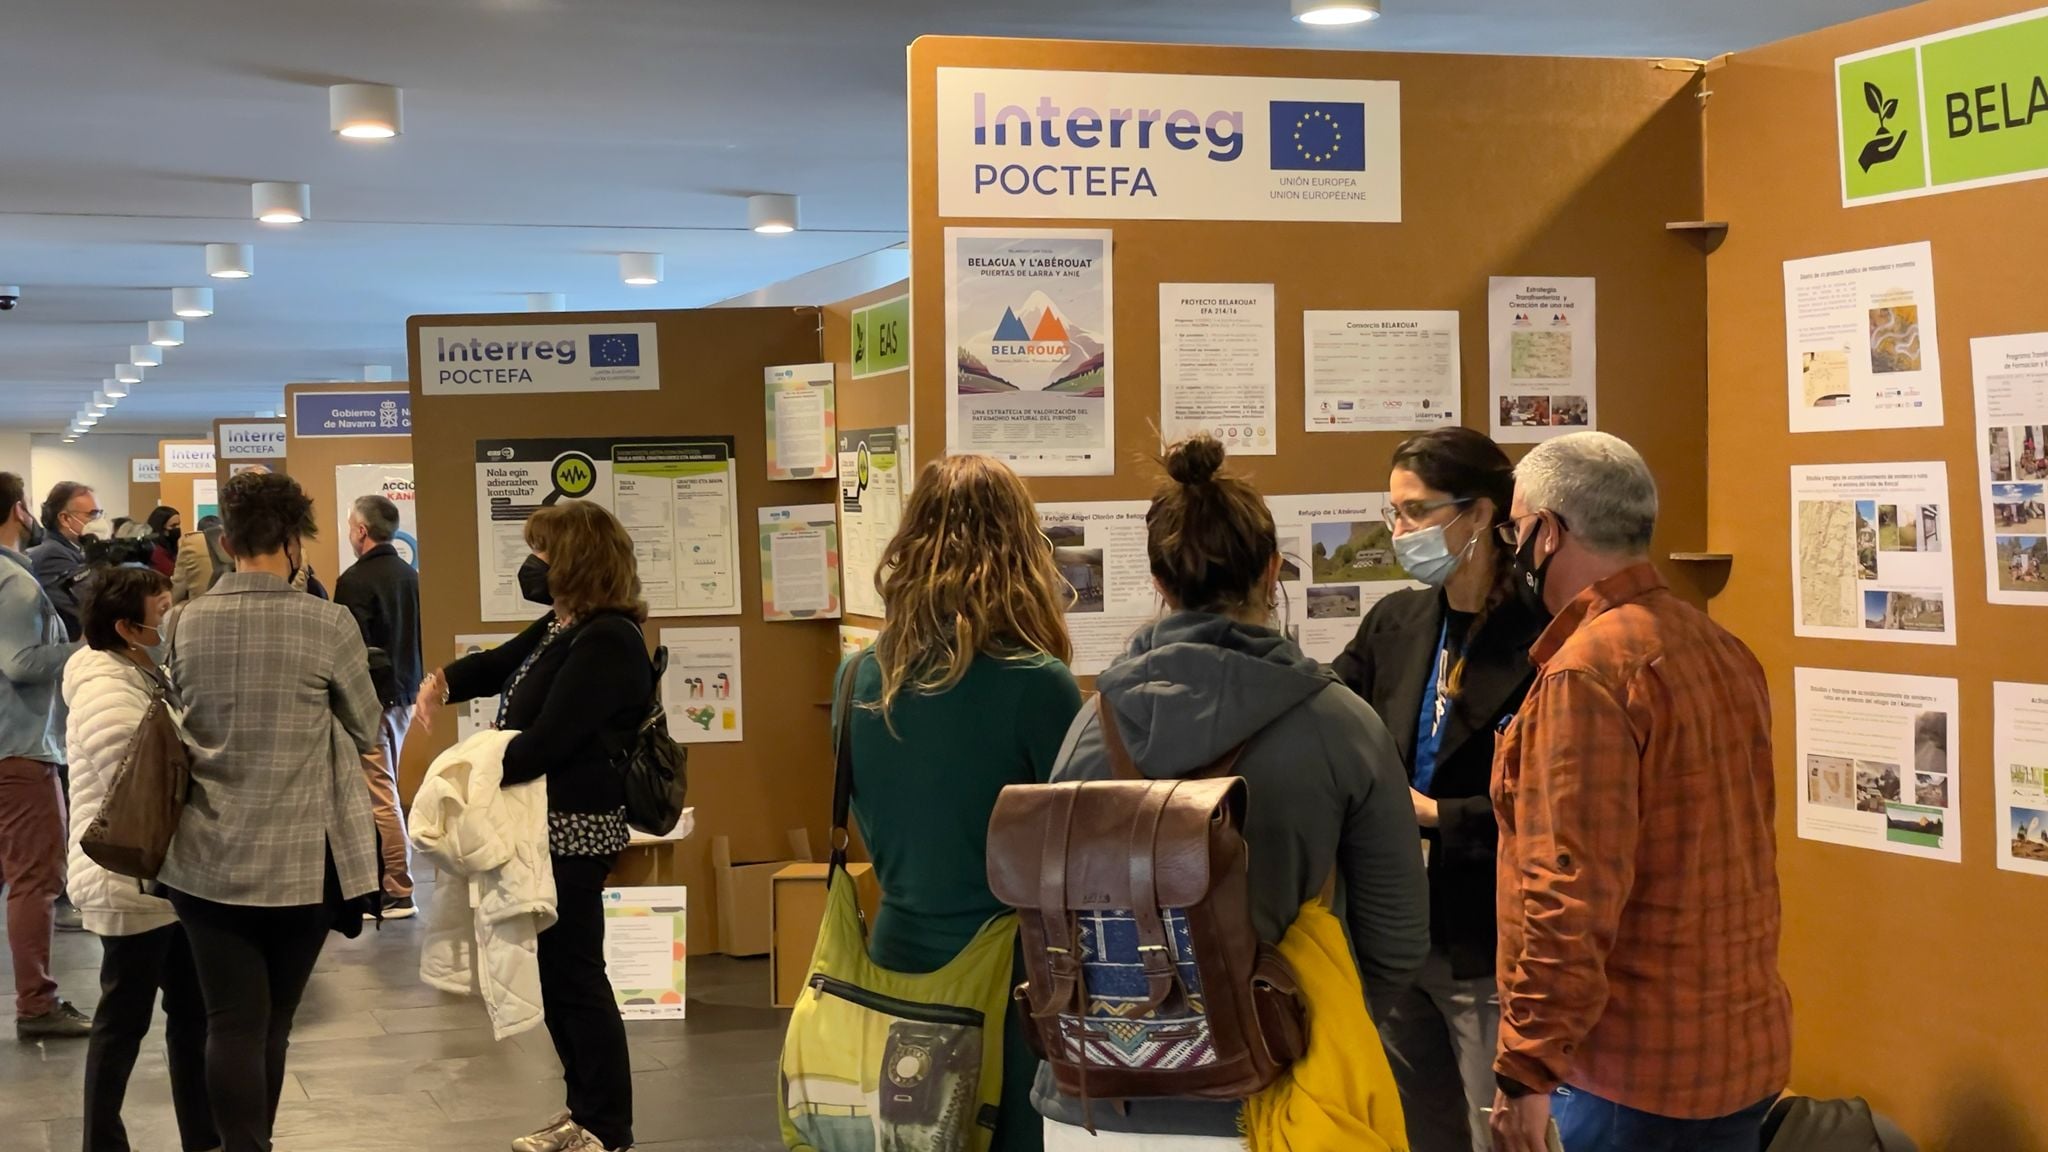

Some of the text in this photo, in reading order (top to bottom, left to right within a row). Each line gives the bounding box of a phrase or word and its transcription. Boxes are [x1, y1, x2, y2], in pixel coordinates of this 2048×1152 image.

[1946, 75, 2048, 139] BELA
[974, 92, 1245, 162] Interreg
[974, 164, 1158, 197] POCTEFA
[1280, 176, 1357, 187] UNIÓN EUROPEA
[1270, 190, 1366, 200] UNION EUROPÉENNE
[968, 256, 1092, 268] BELAGUA Y L'ABÉROUAT
[980, 269, 1015, 277] PUERTAS
[1063, 270, 1080, 278] ANIE
[1181, 298, 1257, 306] PROYECTO BELAROUAT
[1215, 307, 1237, 315] 214/16
[880, 321, 897, 357] EAS
[437, 337, 577, 365] Interreg
[991, 345, 1071, 356] BELAROUAT
[439, 368, 533, 385] POCTEFA
[331, 407, 411, 418] Gobierno N
[323, 420, 336, 429] de
[338, 419, 377, 428] Navarra
[228, 429, 285, 442] Interre
[229, 445, 275, 453] POCTEFA
[486, 467, 529, 478] Nola egin
[487, 477, 539, 487] adierazleen
[487, 488, 534, 497] kontsulta?
[1045, 513, 1070, 523] Refugio
[1298, 509, 1322, 518] Refugio
